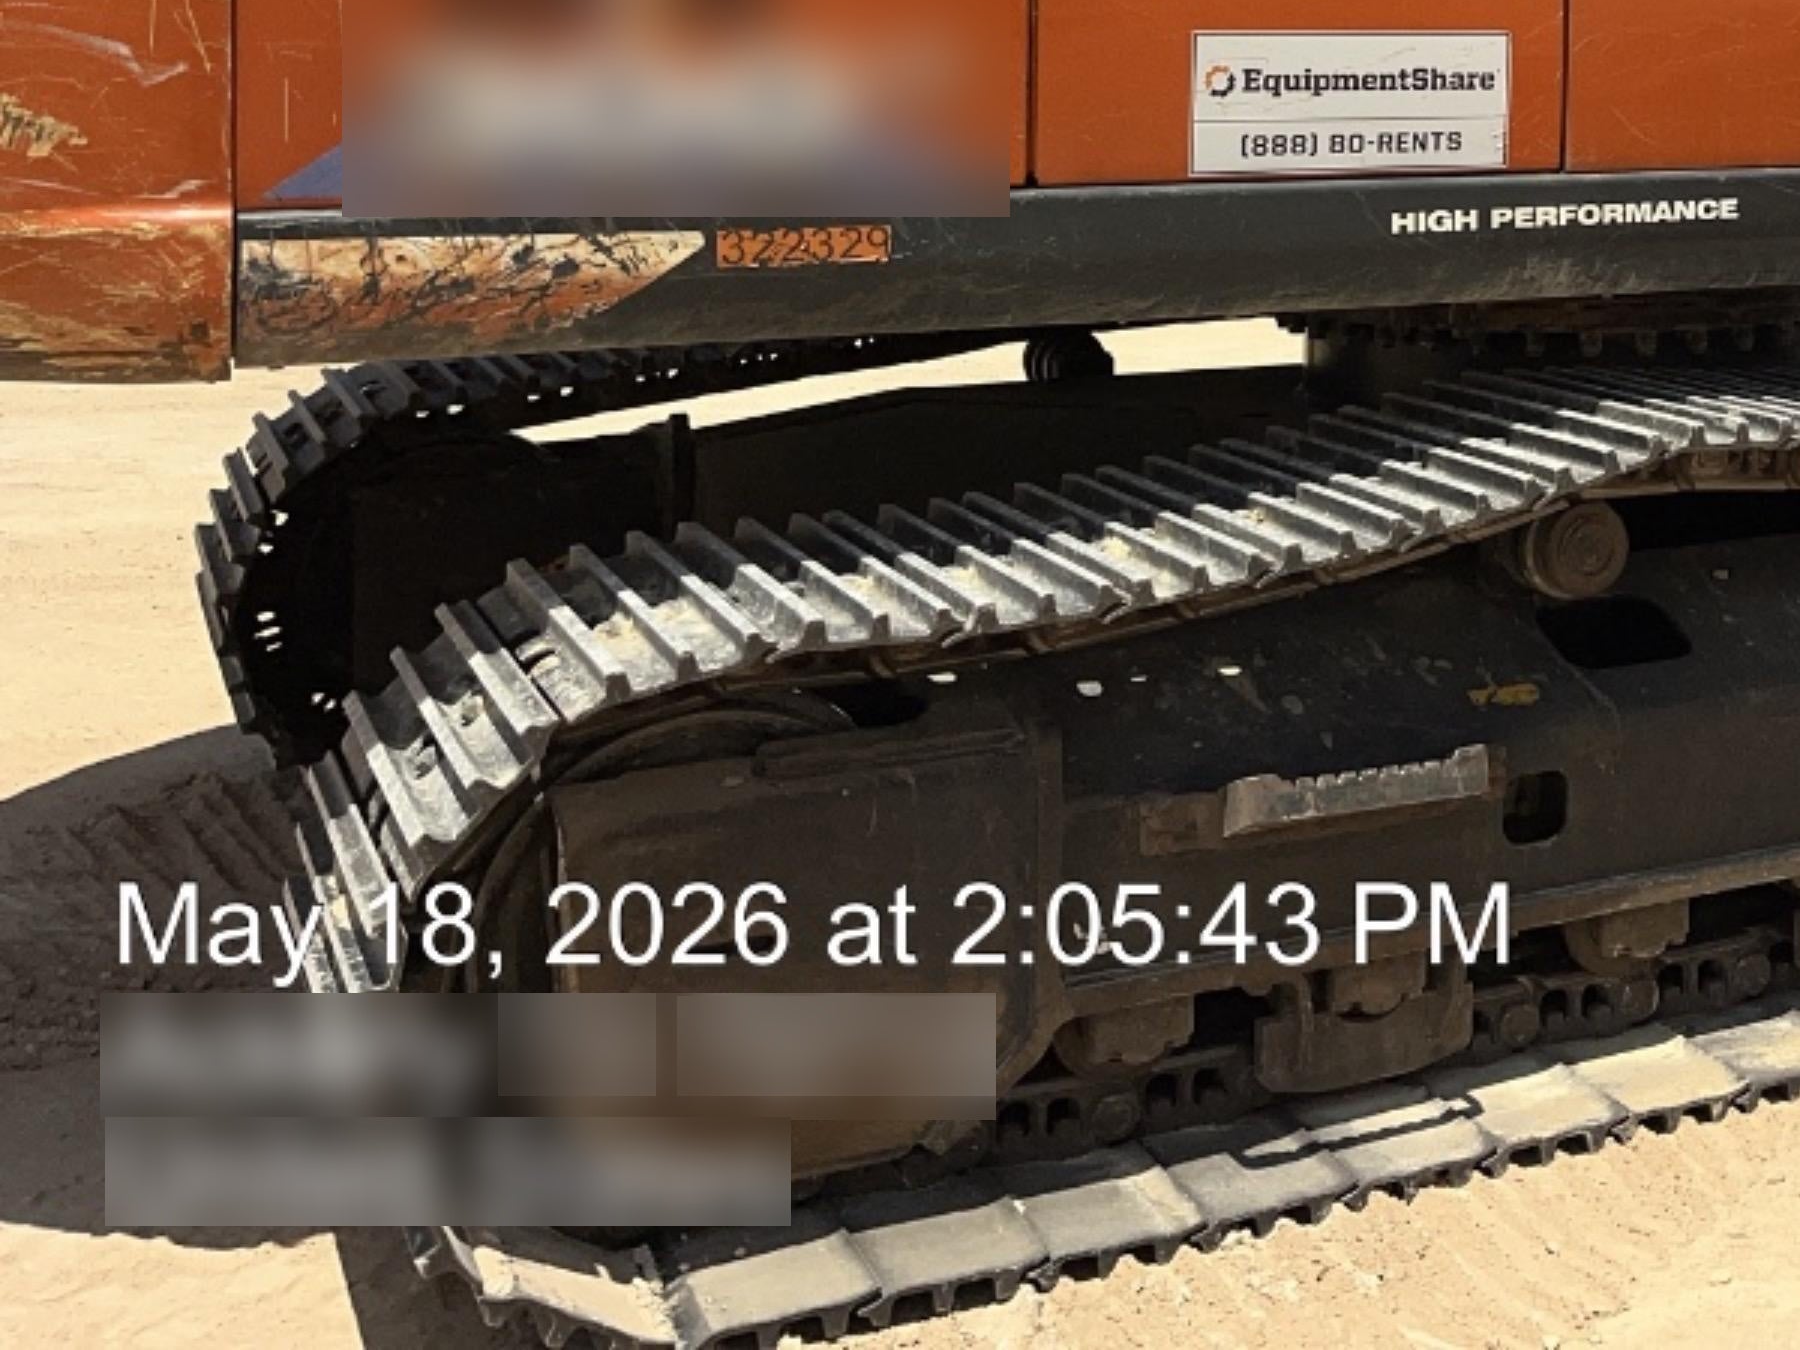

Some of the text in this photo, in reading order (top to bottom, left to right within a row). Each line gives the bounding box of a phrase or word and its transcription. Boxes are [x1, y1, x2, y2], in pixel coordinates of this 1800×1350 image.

[1241, 67, 1496, 97] EquipmentShare
[1240, 131, 1318, 159] (888)
[1390, 197, 1741, 235] HIGH PERFORMANCE
[721, 226, 889, 265] 322329
